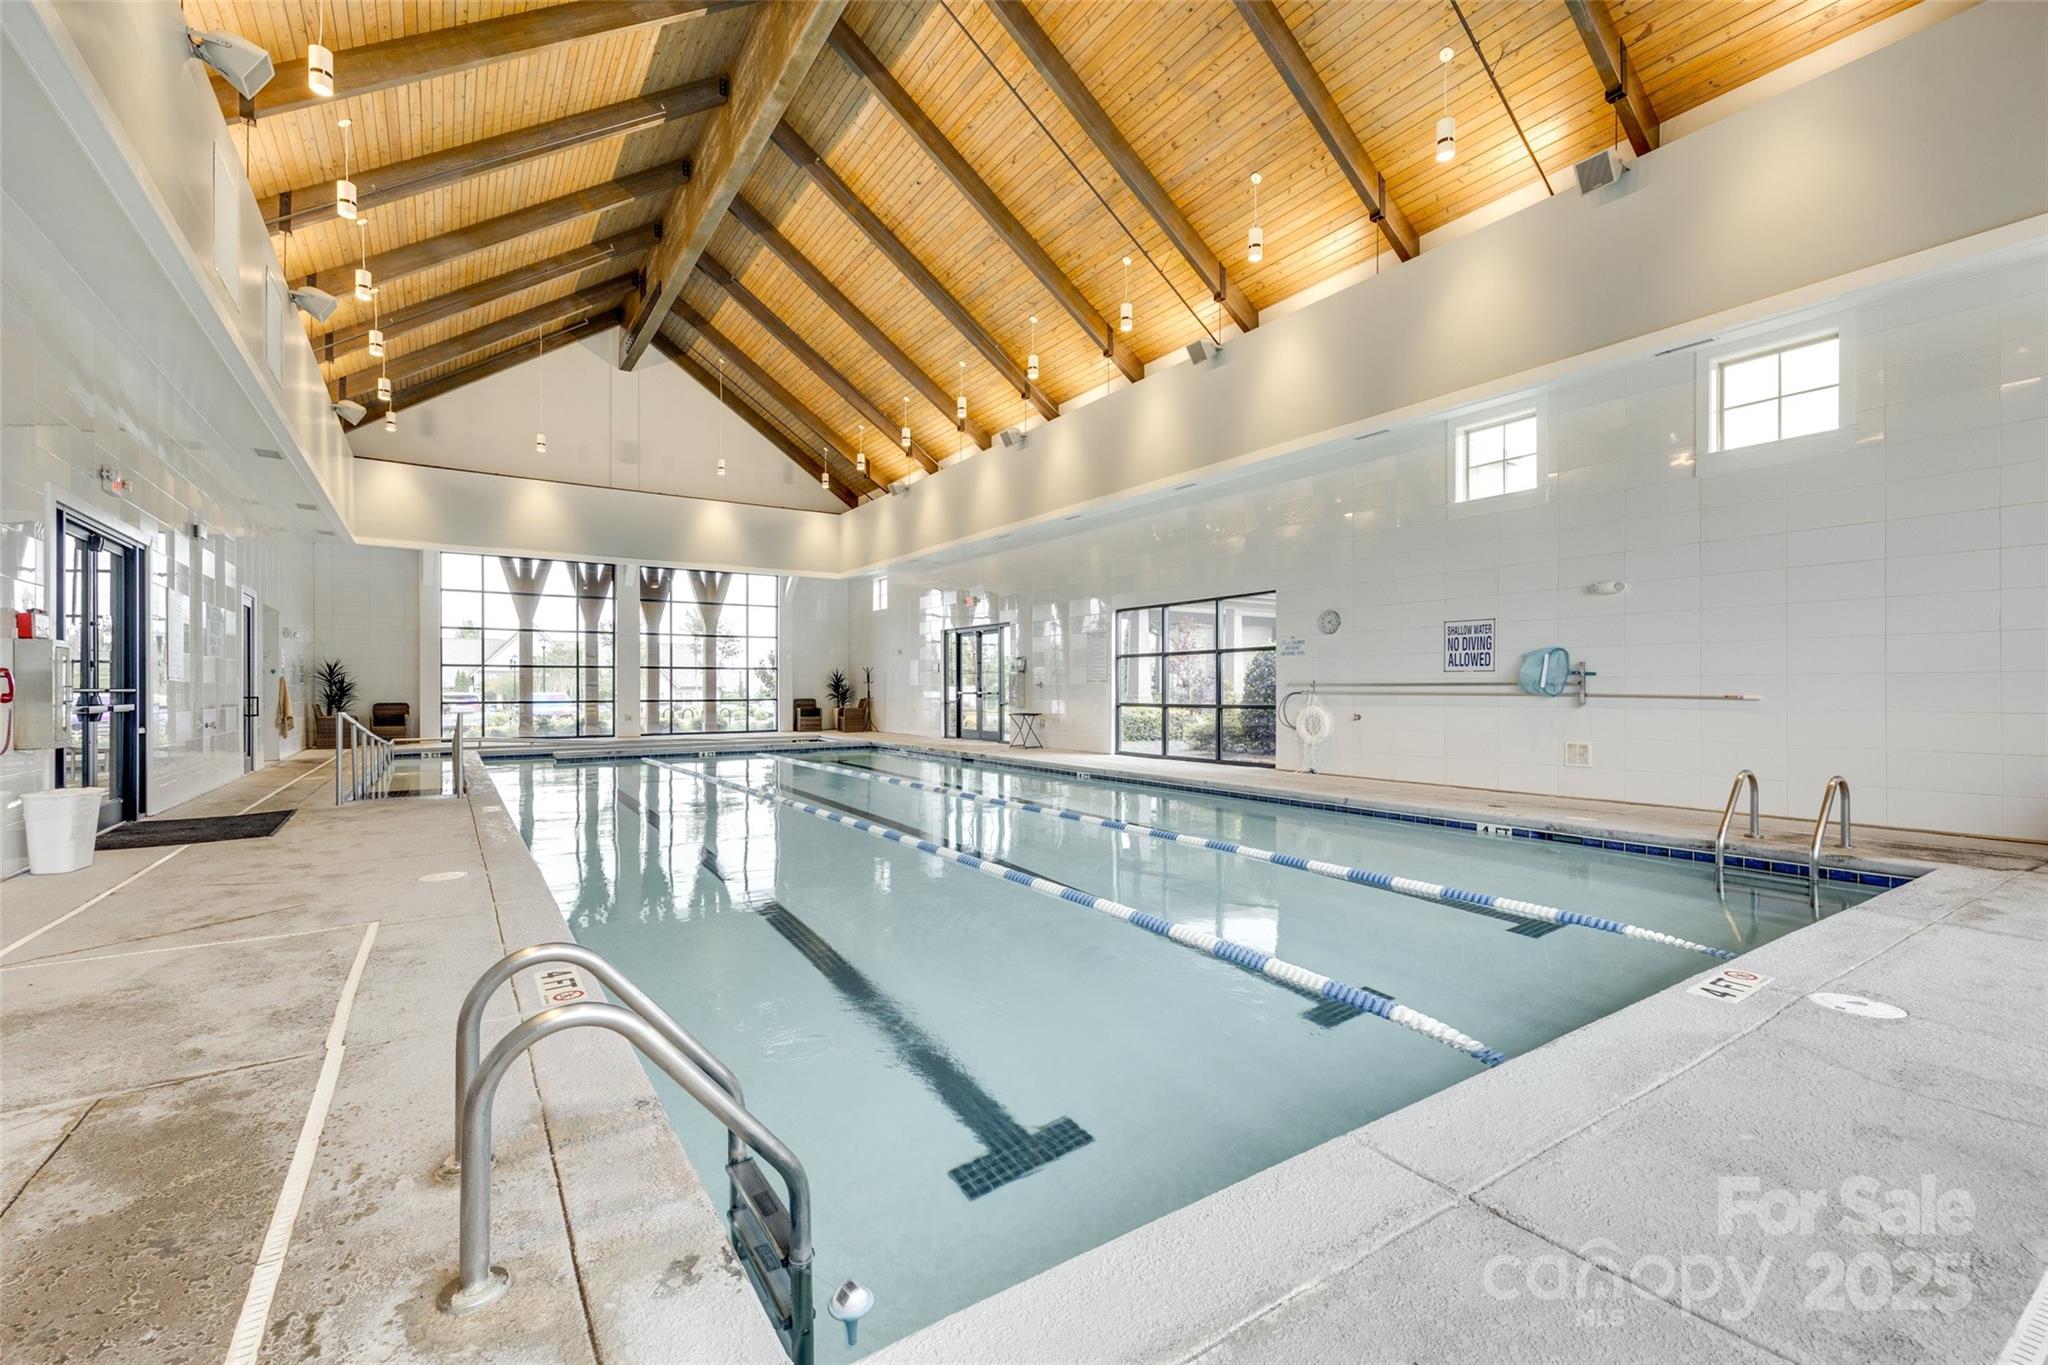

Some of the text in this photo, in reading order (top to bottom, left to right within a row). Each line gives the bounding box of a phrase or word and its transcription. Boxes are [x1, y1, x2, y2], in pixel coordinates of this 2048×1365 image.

[1447, 623, 1492, 636] SHALLOW WATER
[1447, 635, 1492, 651] NO DIVING
[1448, 652, 1491, 667] ALLOWED
